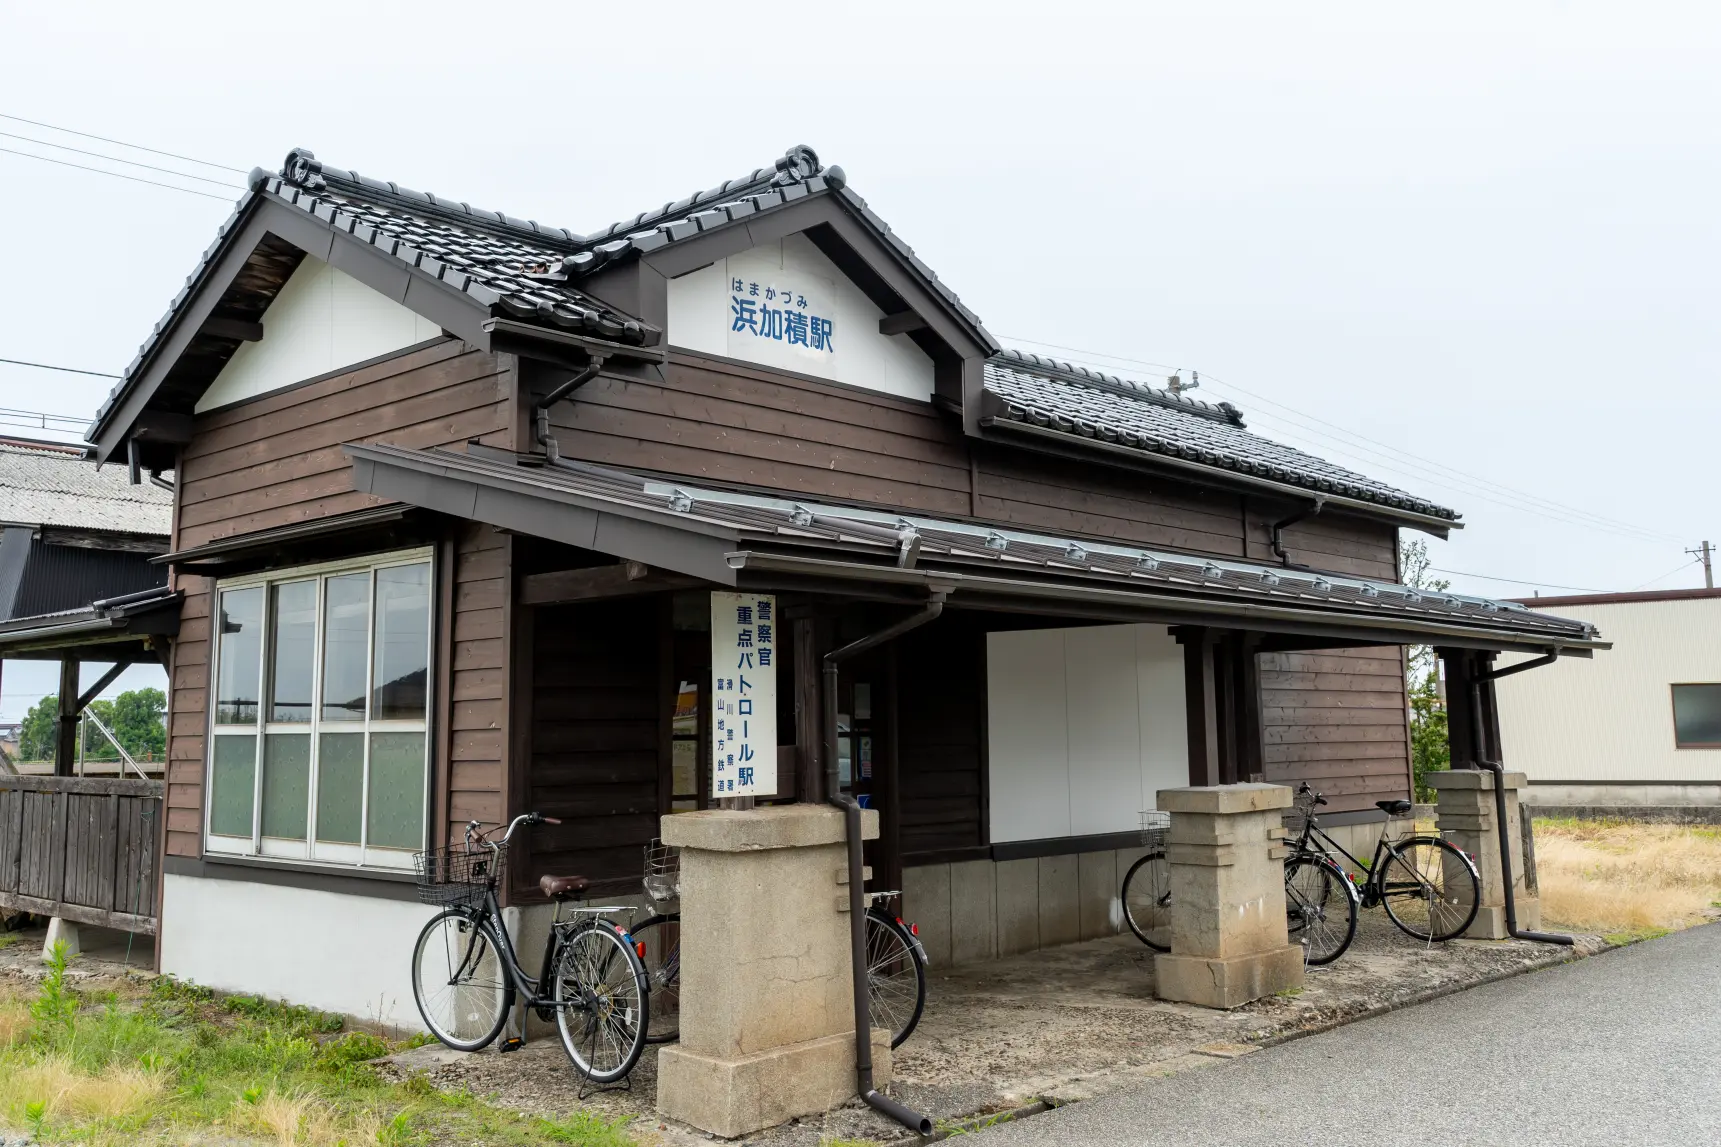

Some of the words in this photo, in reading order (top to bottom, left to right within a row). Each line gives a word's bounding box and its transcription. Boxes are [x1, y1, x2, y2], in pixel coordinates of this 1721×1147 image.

[731, 277, 808, 309] はまかづみ
[731, 295, 833, 353] 浜加積駅
[757, 600, 772, 667] 警察官
[736, 605, 754, 787] 重点パトロール駅
[726, 678, 734, 792] 滑川警察署
